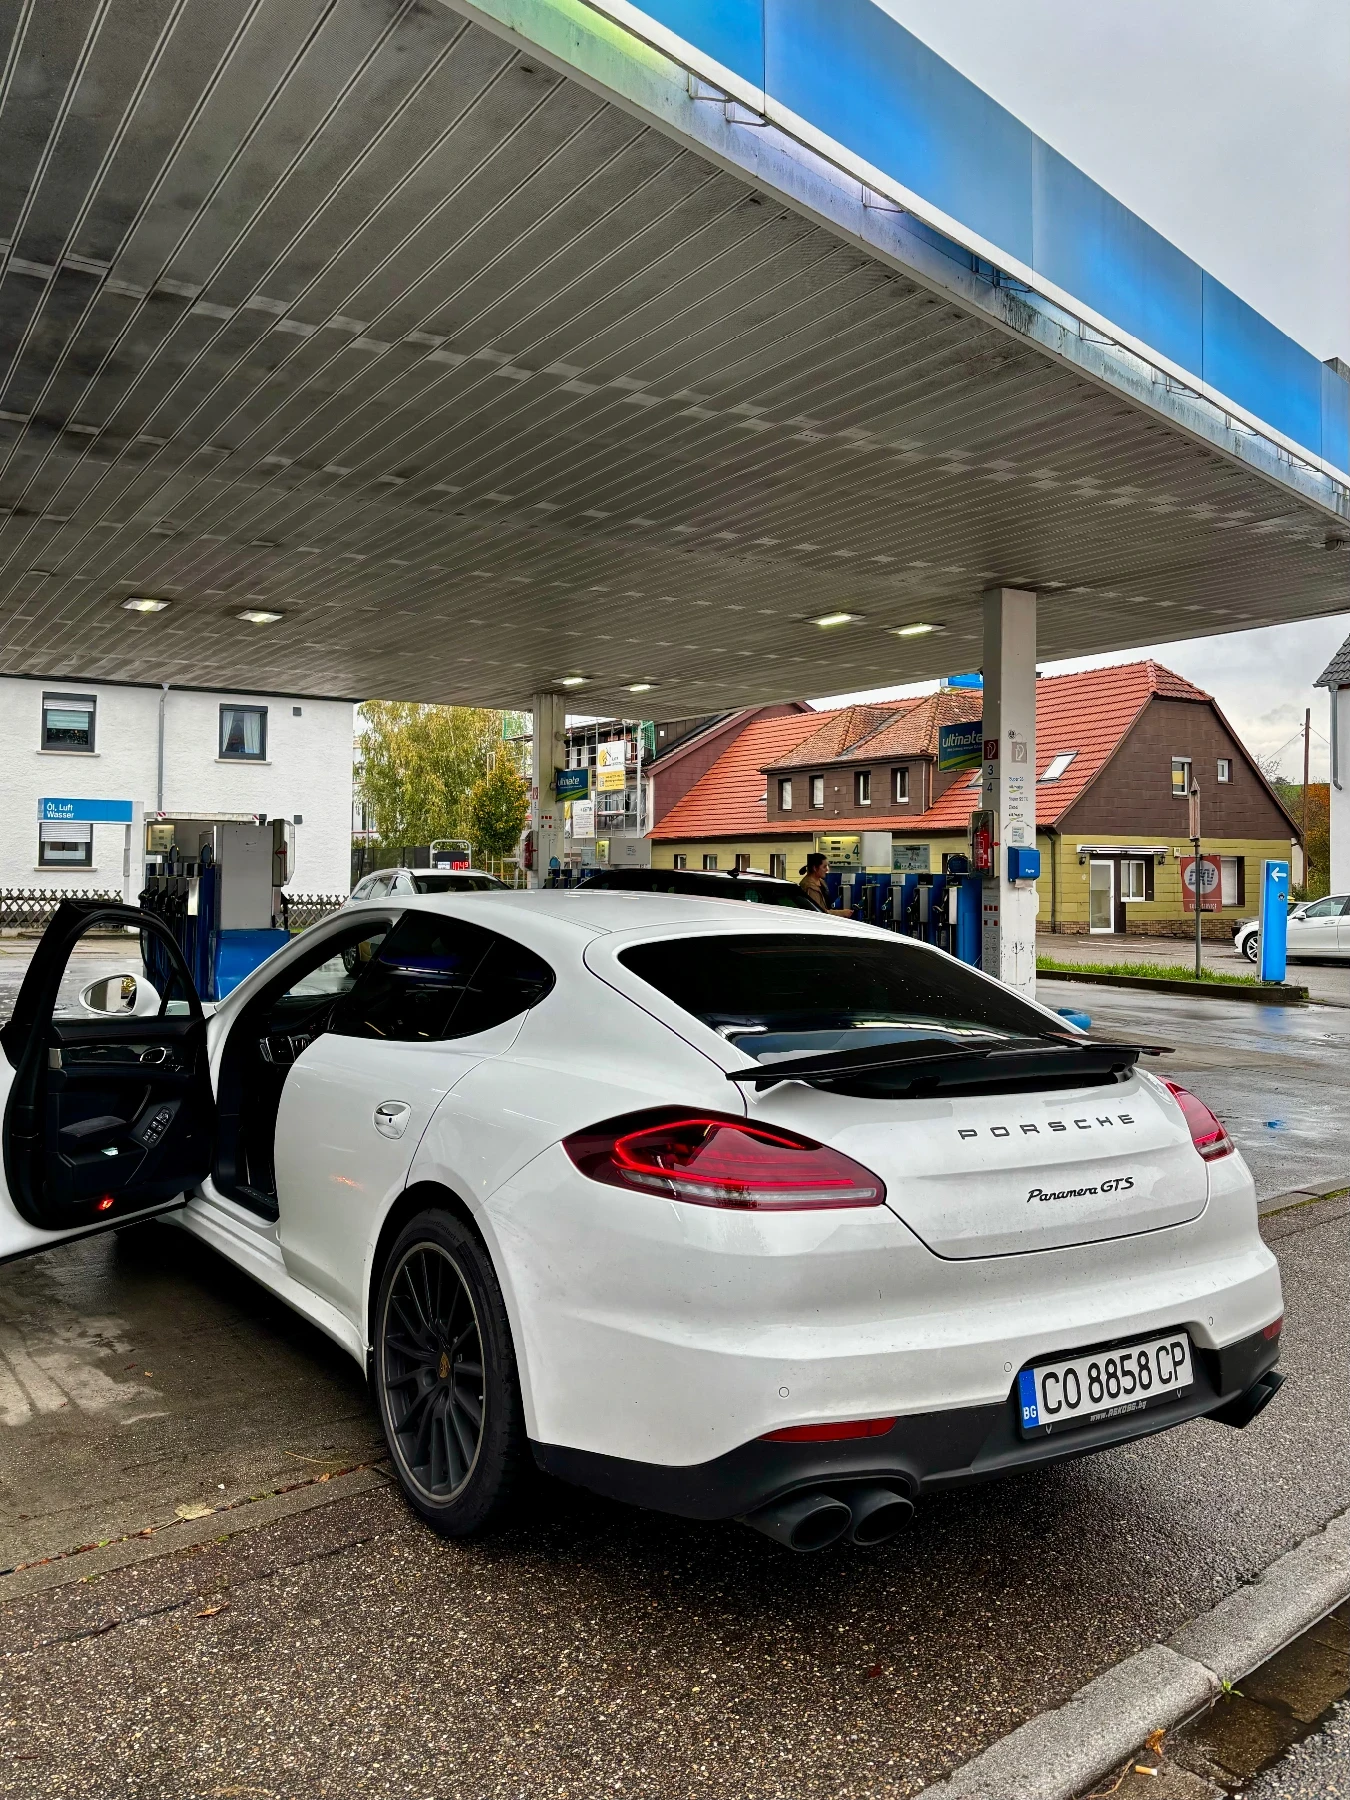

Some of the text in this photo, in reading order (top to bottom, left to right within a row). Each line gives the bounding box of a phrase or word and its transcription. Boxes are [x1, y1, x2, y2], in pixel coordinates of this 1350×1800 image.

[942, 731, 983, 747] ultimate
[988, 764, 994, 775] 3
[987, 782, 993, 793] 4
[59, 803, 73, 811] Luft
[852, 844, 860, 857] 4
[957, 1113, 1135, 1140] PORSCHE
[1026, 1176, 1135, 1203] Panamera GTS
[1023, 1341, 1186, 1420] BG CO 8858 CP
